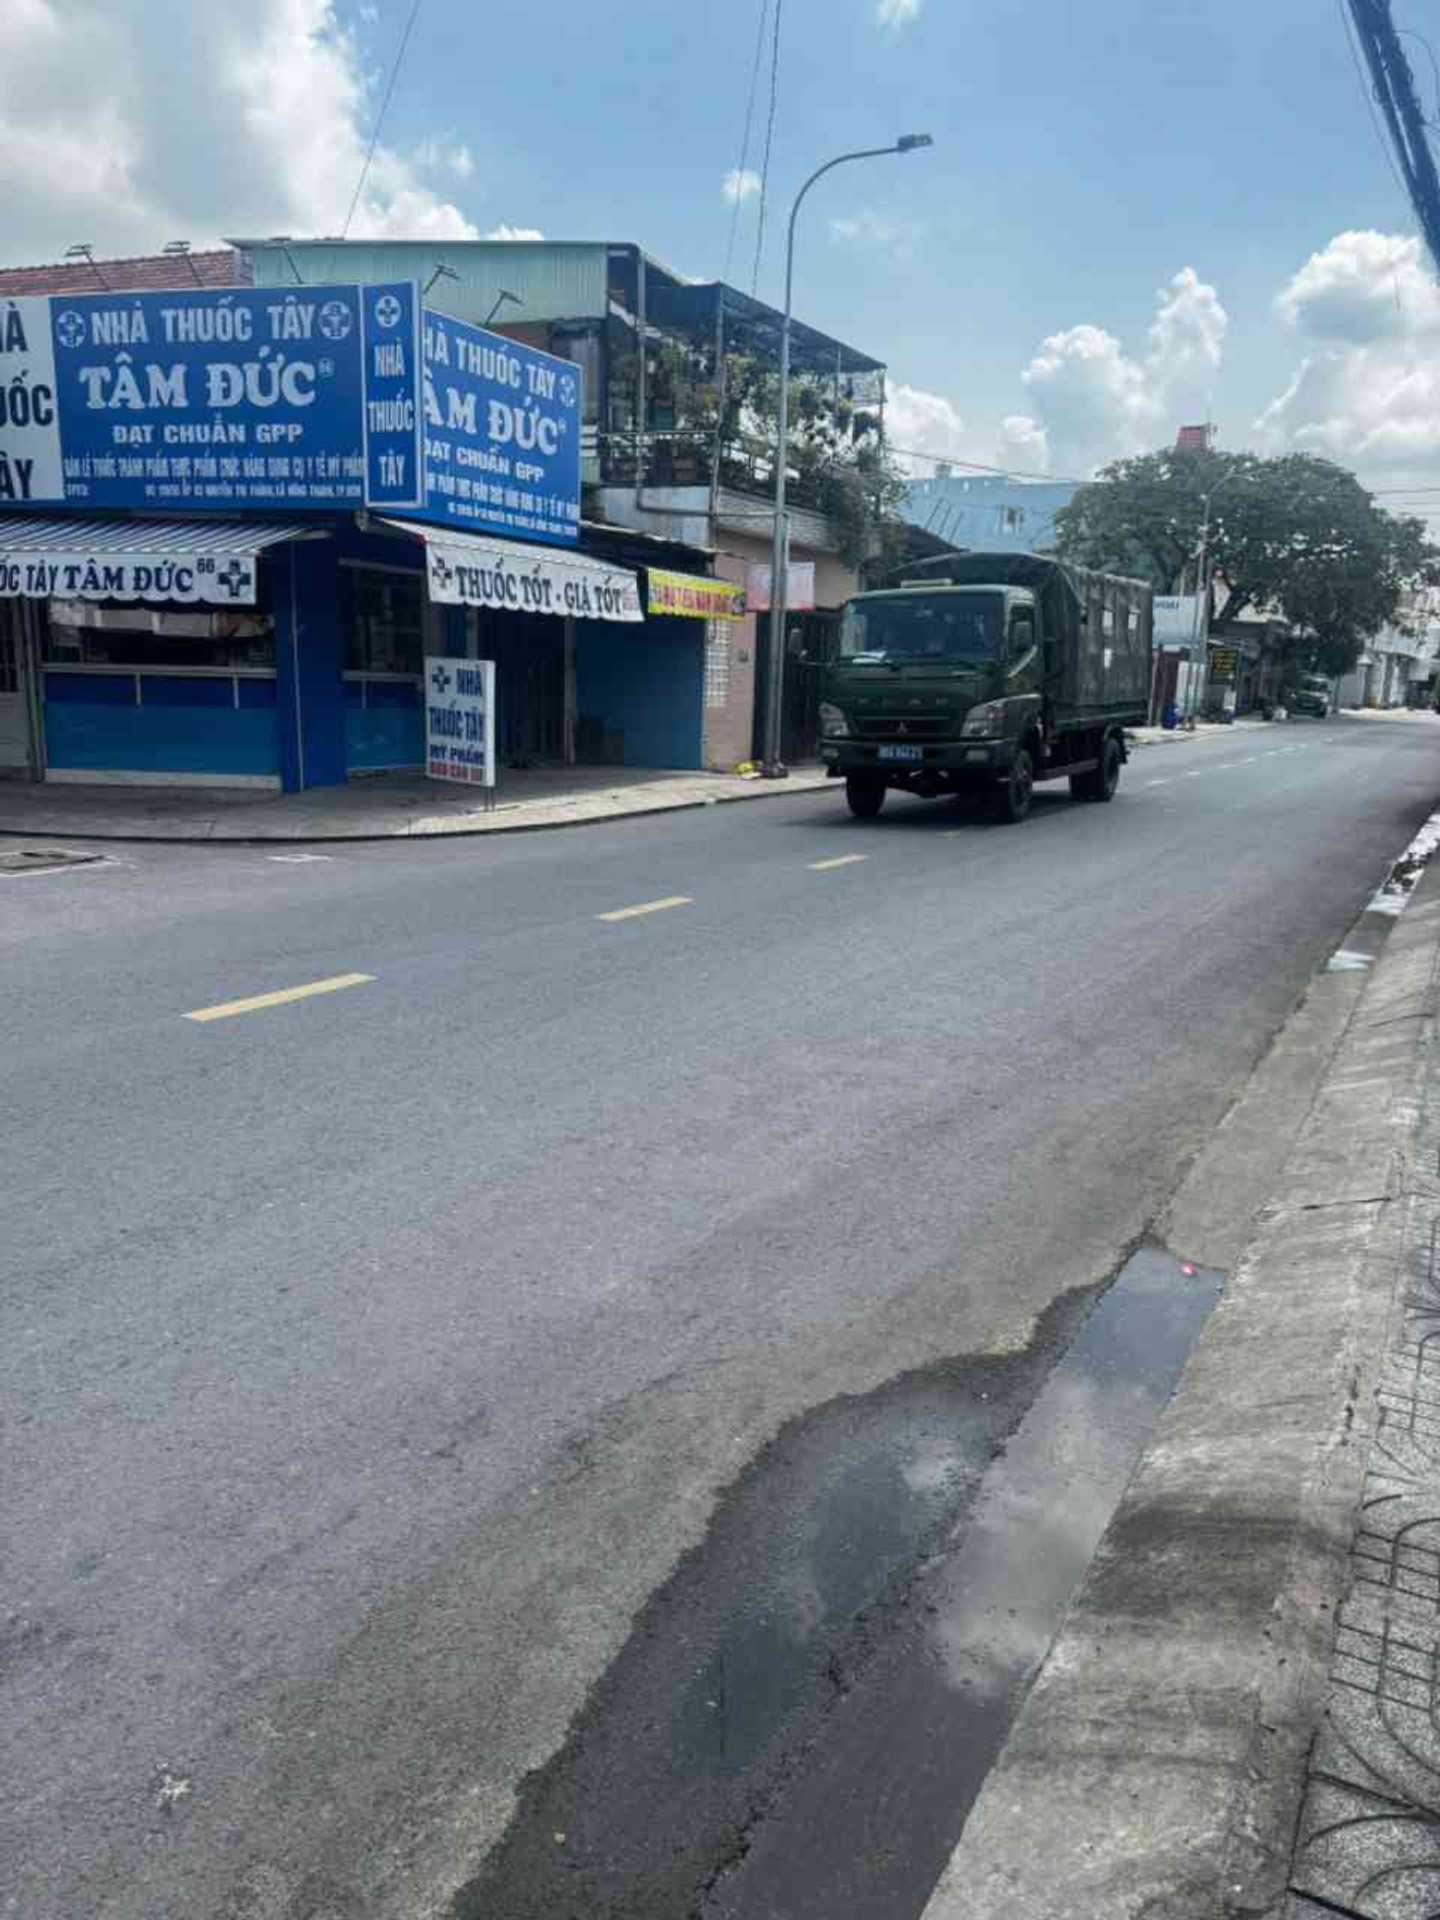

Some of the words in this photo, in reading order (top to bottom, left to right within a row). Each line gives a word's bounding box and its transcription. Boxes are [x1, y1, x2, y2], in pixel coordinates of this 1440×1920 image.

[92, 300, 148, 345] NHÀ
[161, 296, 253, 343] THUỐC
[267, 295, 315, 340] TÂY
[79, 352, 189, 409] TÂM
[206, 346, 316, 408] ĐỨC
[374, 337, 406, 377] NHÀ
[422, 322, 450, 366] HÀ
[456, 338, 521, 390] THUỐC
[526, 363, 556, 398] TÂY
[112, 424, 155, 449] ĐẠT
[164, 414, 246, 444] CHUẨN
[256, 424, 303, 443] GPP
[368, 387, 414, 433] THUỐC
[423, 366, 477, 434] ÂM
[487, 395, 559, 456] ĐỨC
[379, 449, 406, 488] TÂY
[456, 444, 510, 474] CHUẨN
[516, 461, 545, 482] GPP
[26, 558, 58, 593] TÂY
[64, 558, 124, 591] TÂM
[133, 560, 193, 593] ĐỨC
[455, 557, 517, 604] THUỐC
[520, 565, 551, 605] TỐT
[564, 577, 591, 612] GIÁ
[595, 575, 622, 614] TỐT
[456, 664, 483, 697] NHÀ
